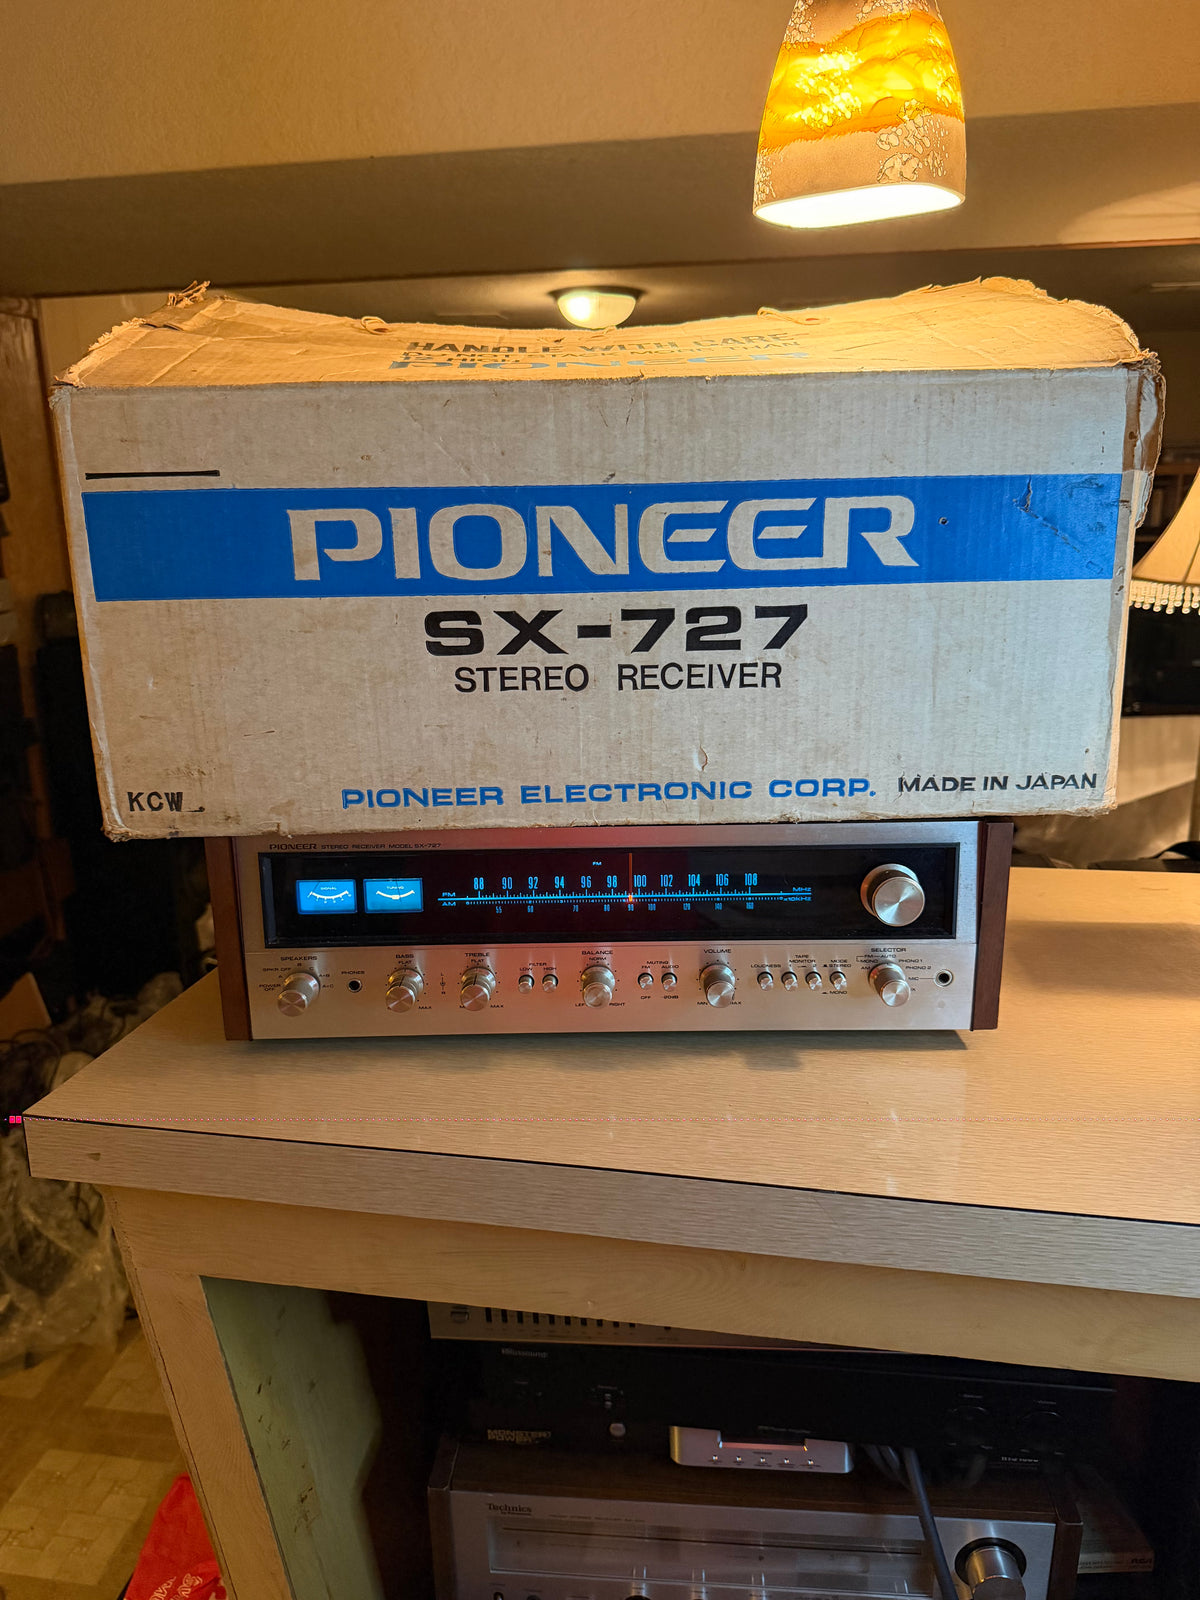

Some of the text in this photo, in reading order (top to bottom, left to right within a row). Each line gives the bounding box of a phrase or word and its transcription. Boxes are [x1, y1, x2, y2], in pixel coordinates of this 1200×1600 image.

[406, 332, 795, 353] HANDLE WITH CARE
[388, 352, 810, 370] PIONEER
[286, 495, 919, 581] PIONEER
[424, 604, 808, 656] SX-727
[455, 662, 782, 693] STEREO RECEIVER
[127, 790, 184, 813] KCW
[341, 772, 1098, 809] PIONEER ELECTRONIC CORP. MADE IN JAPAN
[473, 872, 758, 890] 88 90 92 94 96 98 100 102 104 106 108
[495, 905, 503, 914] 55
[572, 904, 579, 913] 70
[487, 1503, 533, 1513] Technics
